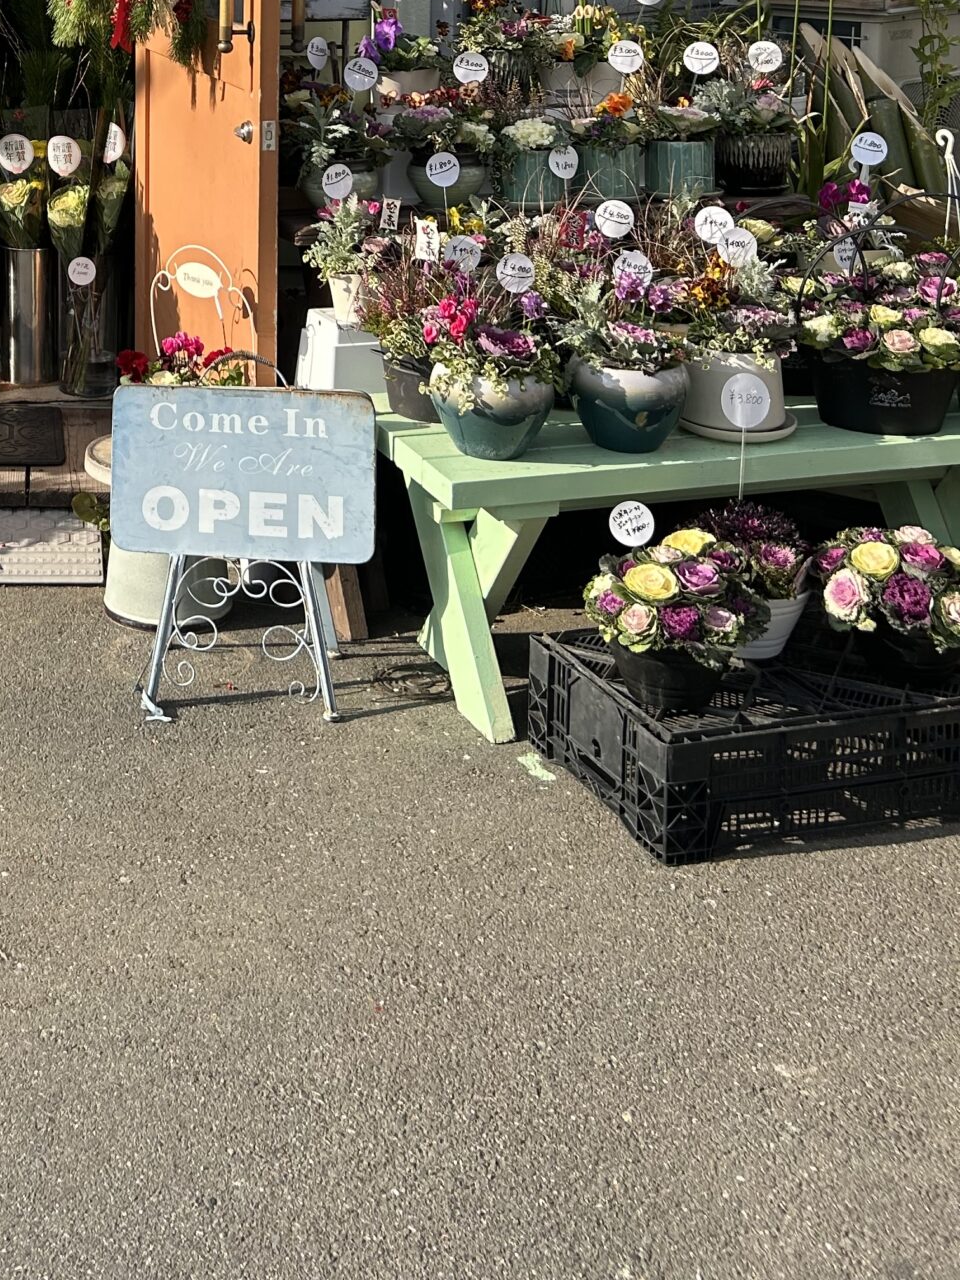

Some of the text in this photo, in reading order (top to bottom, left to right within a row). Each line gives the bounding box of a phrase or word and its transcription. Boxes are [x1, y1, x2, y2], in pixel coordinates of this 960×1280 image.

[149, 402, 329, 439] Come In
[173, 441, 313, 477] We Are
[141, 484, 344, 540] OPEN
